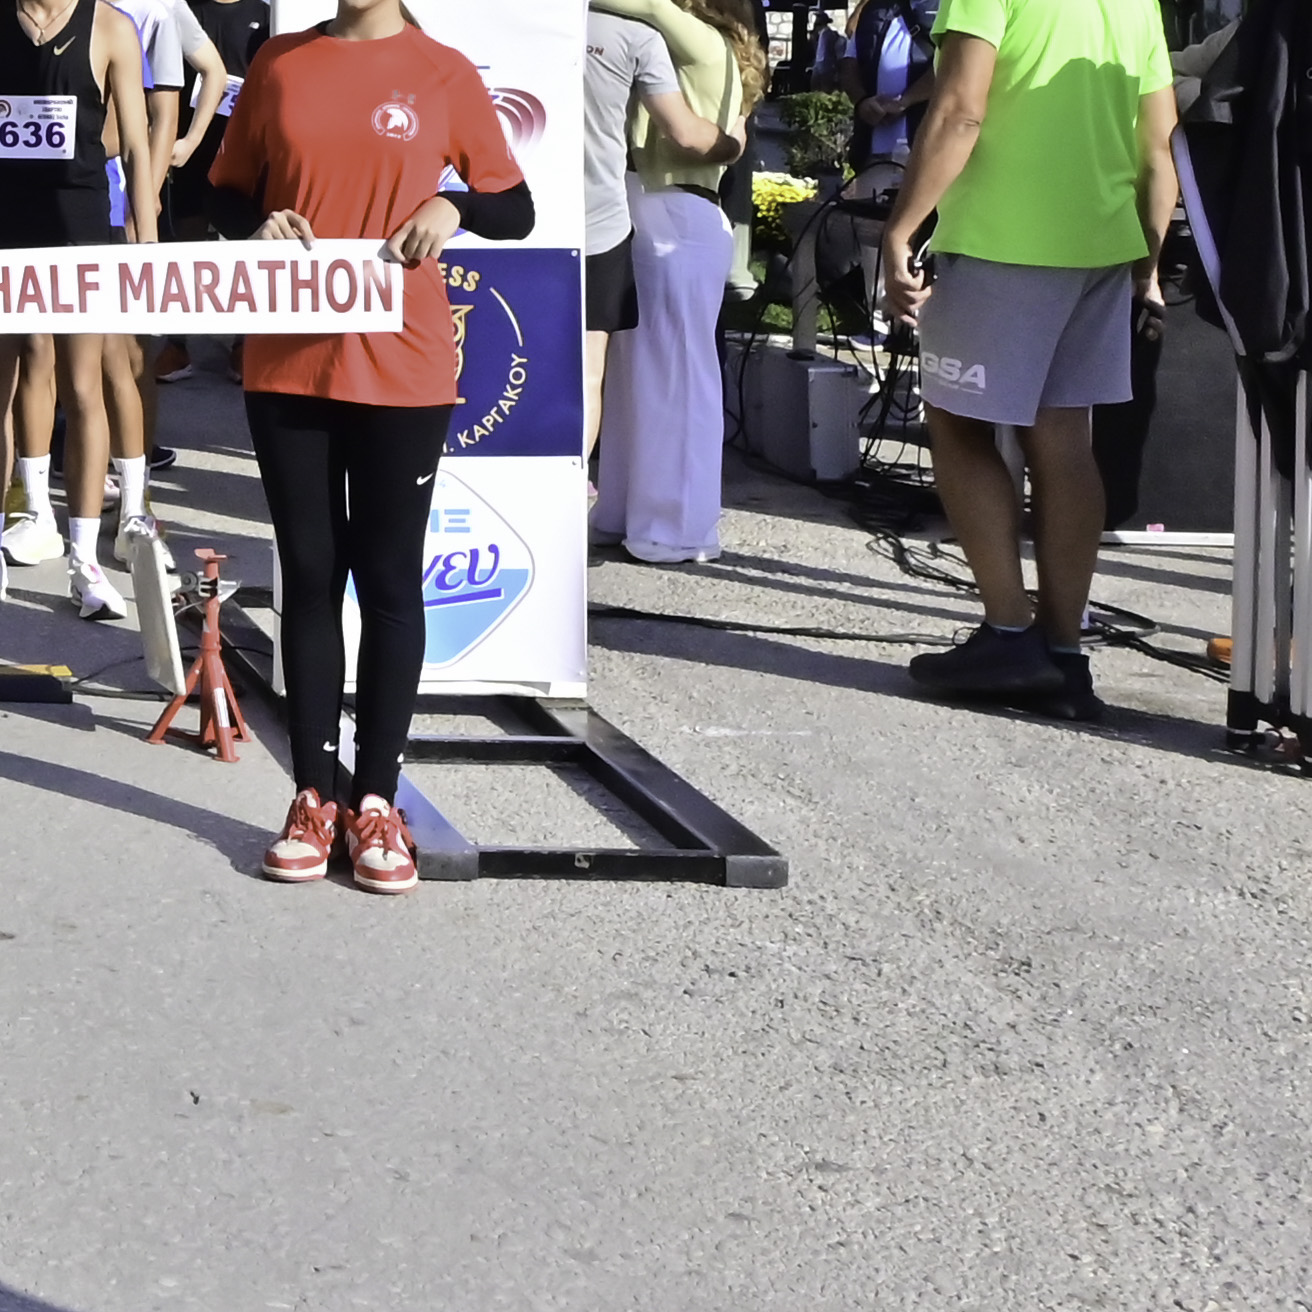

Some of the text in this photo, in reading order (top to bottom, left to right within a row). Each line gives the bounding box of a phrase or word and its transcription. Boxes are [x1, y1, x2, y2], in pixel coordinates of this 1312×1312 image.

[119, 258, 393, 314] MARATHON
[920, 351, 986, 389] GSA
[457, 353, 529, 449] ΚΑΡΓΑΚΟΥ
